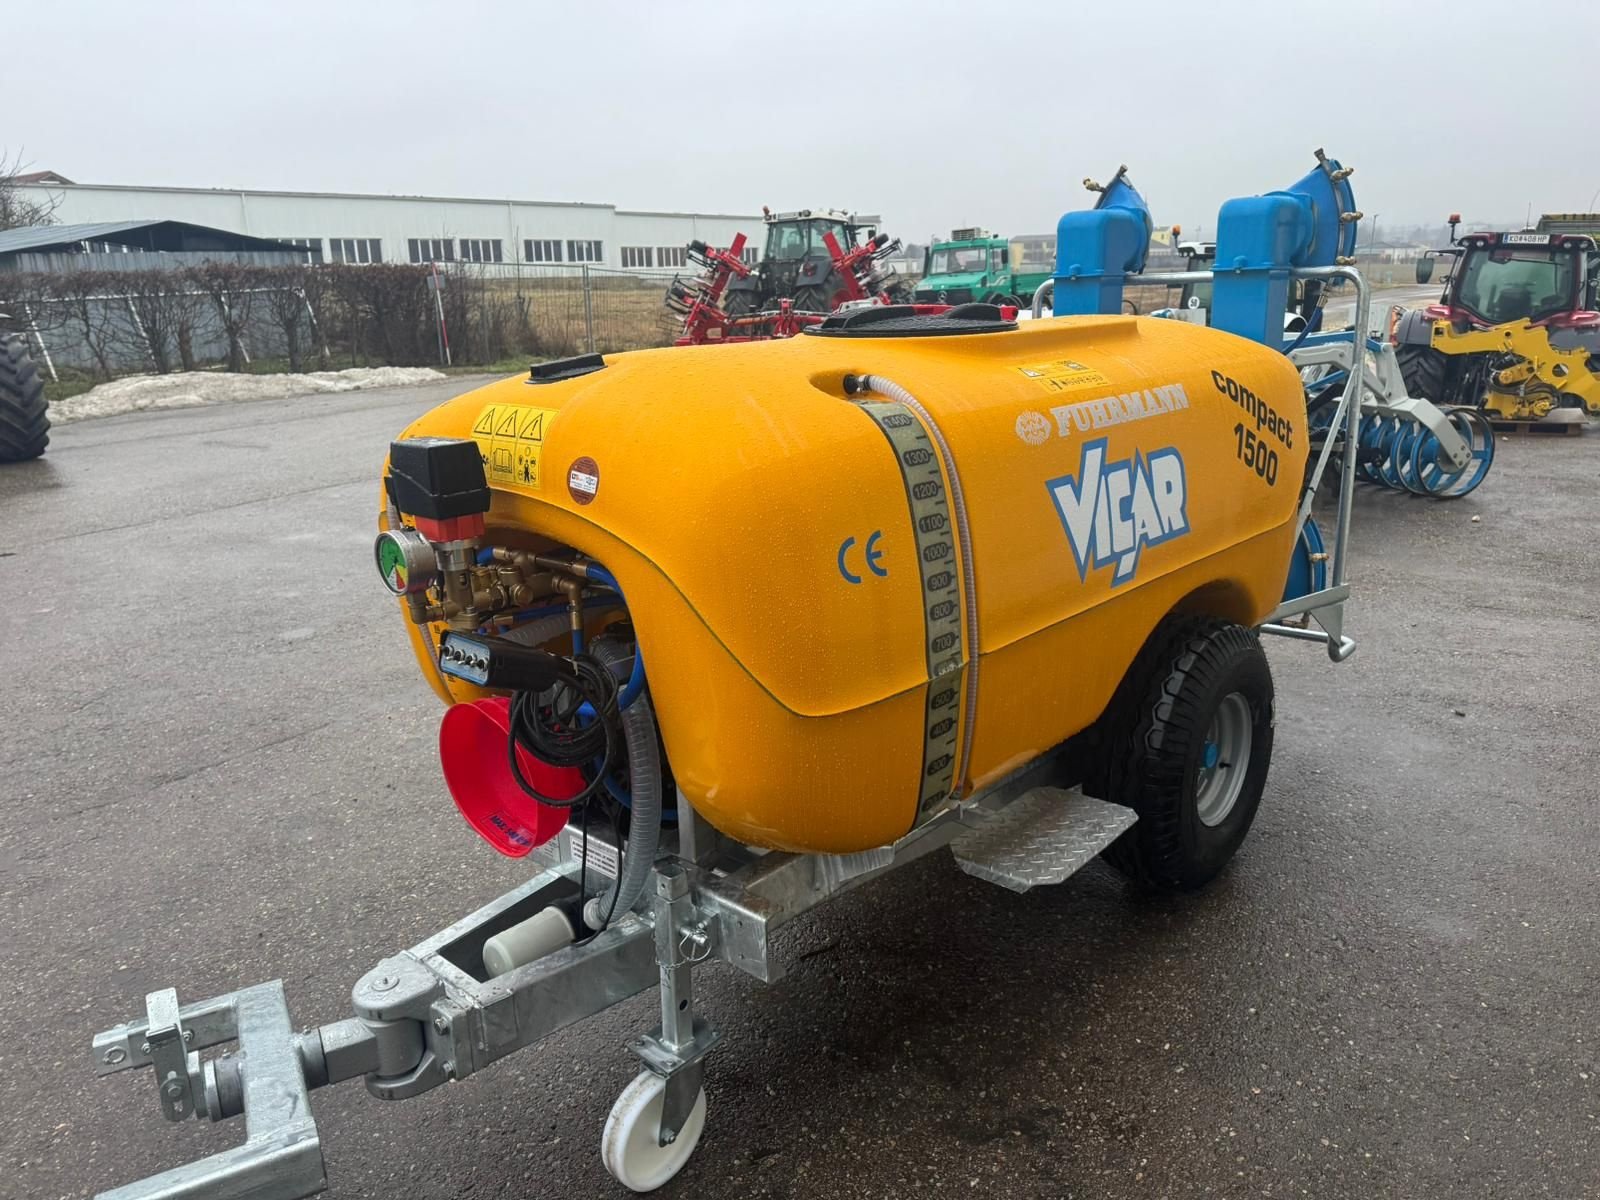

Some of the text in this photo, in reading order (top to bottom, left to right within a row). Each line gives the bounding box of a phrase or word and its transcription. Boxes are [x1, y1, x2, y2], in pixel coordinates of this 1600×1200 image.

[1050, 384, 1189, 437] FUHRMANN
[1211, 369, 1293, 450] compact
[885, 414, 911, 428] 1400
[905, 449, 930, 465] 1300
[1234, 422, 1279, 487] 1500
[914, 482, 938, 499] 1200
[920, 515, 944, 531] 1100
[838, 530, 888, 584] CE
[925, 544, 948, 560] 1000
[931, 574, 948, 590] 900
[934, 602, 952, 618] 800
[935, 633, 953, 649] 700
